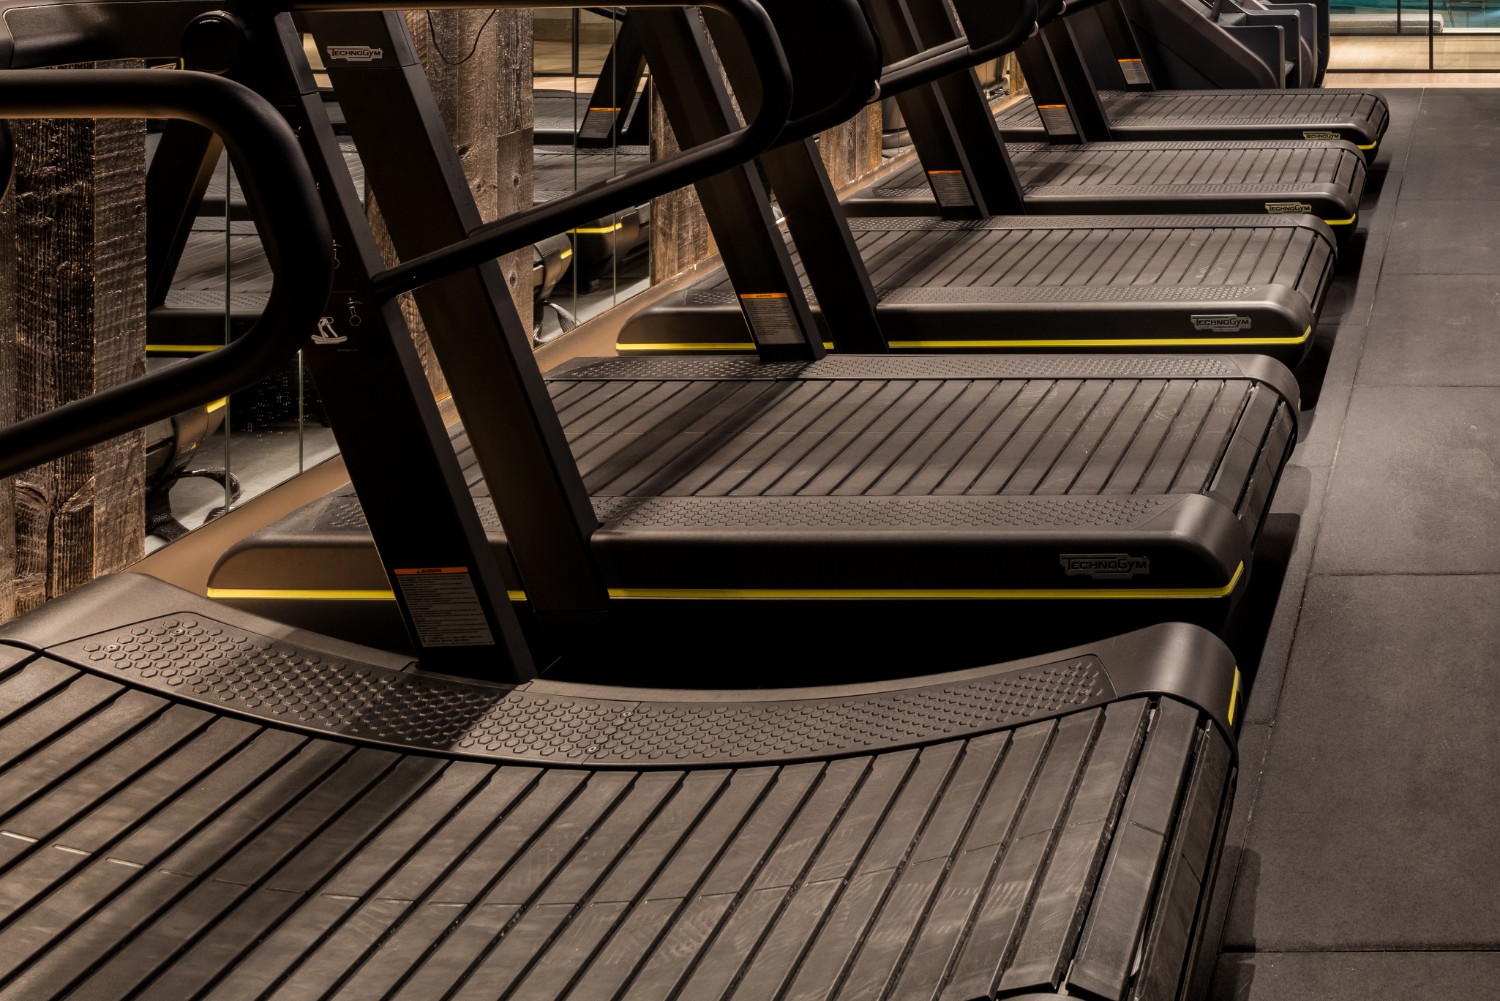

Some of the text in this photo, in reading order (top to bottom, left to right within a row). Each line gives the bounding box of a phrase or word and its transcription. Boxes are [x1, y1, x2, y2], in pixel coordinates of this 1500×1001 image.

[328, 47, 381, 59] TECHNOGYM
[1266, 203, 1311, 212] TECHNOGYM
[1192, 315, 1250, 330] TECHNOGYM
[1061, 556, 1147, 574] TECHNOGYM
